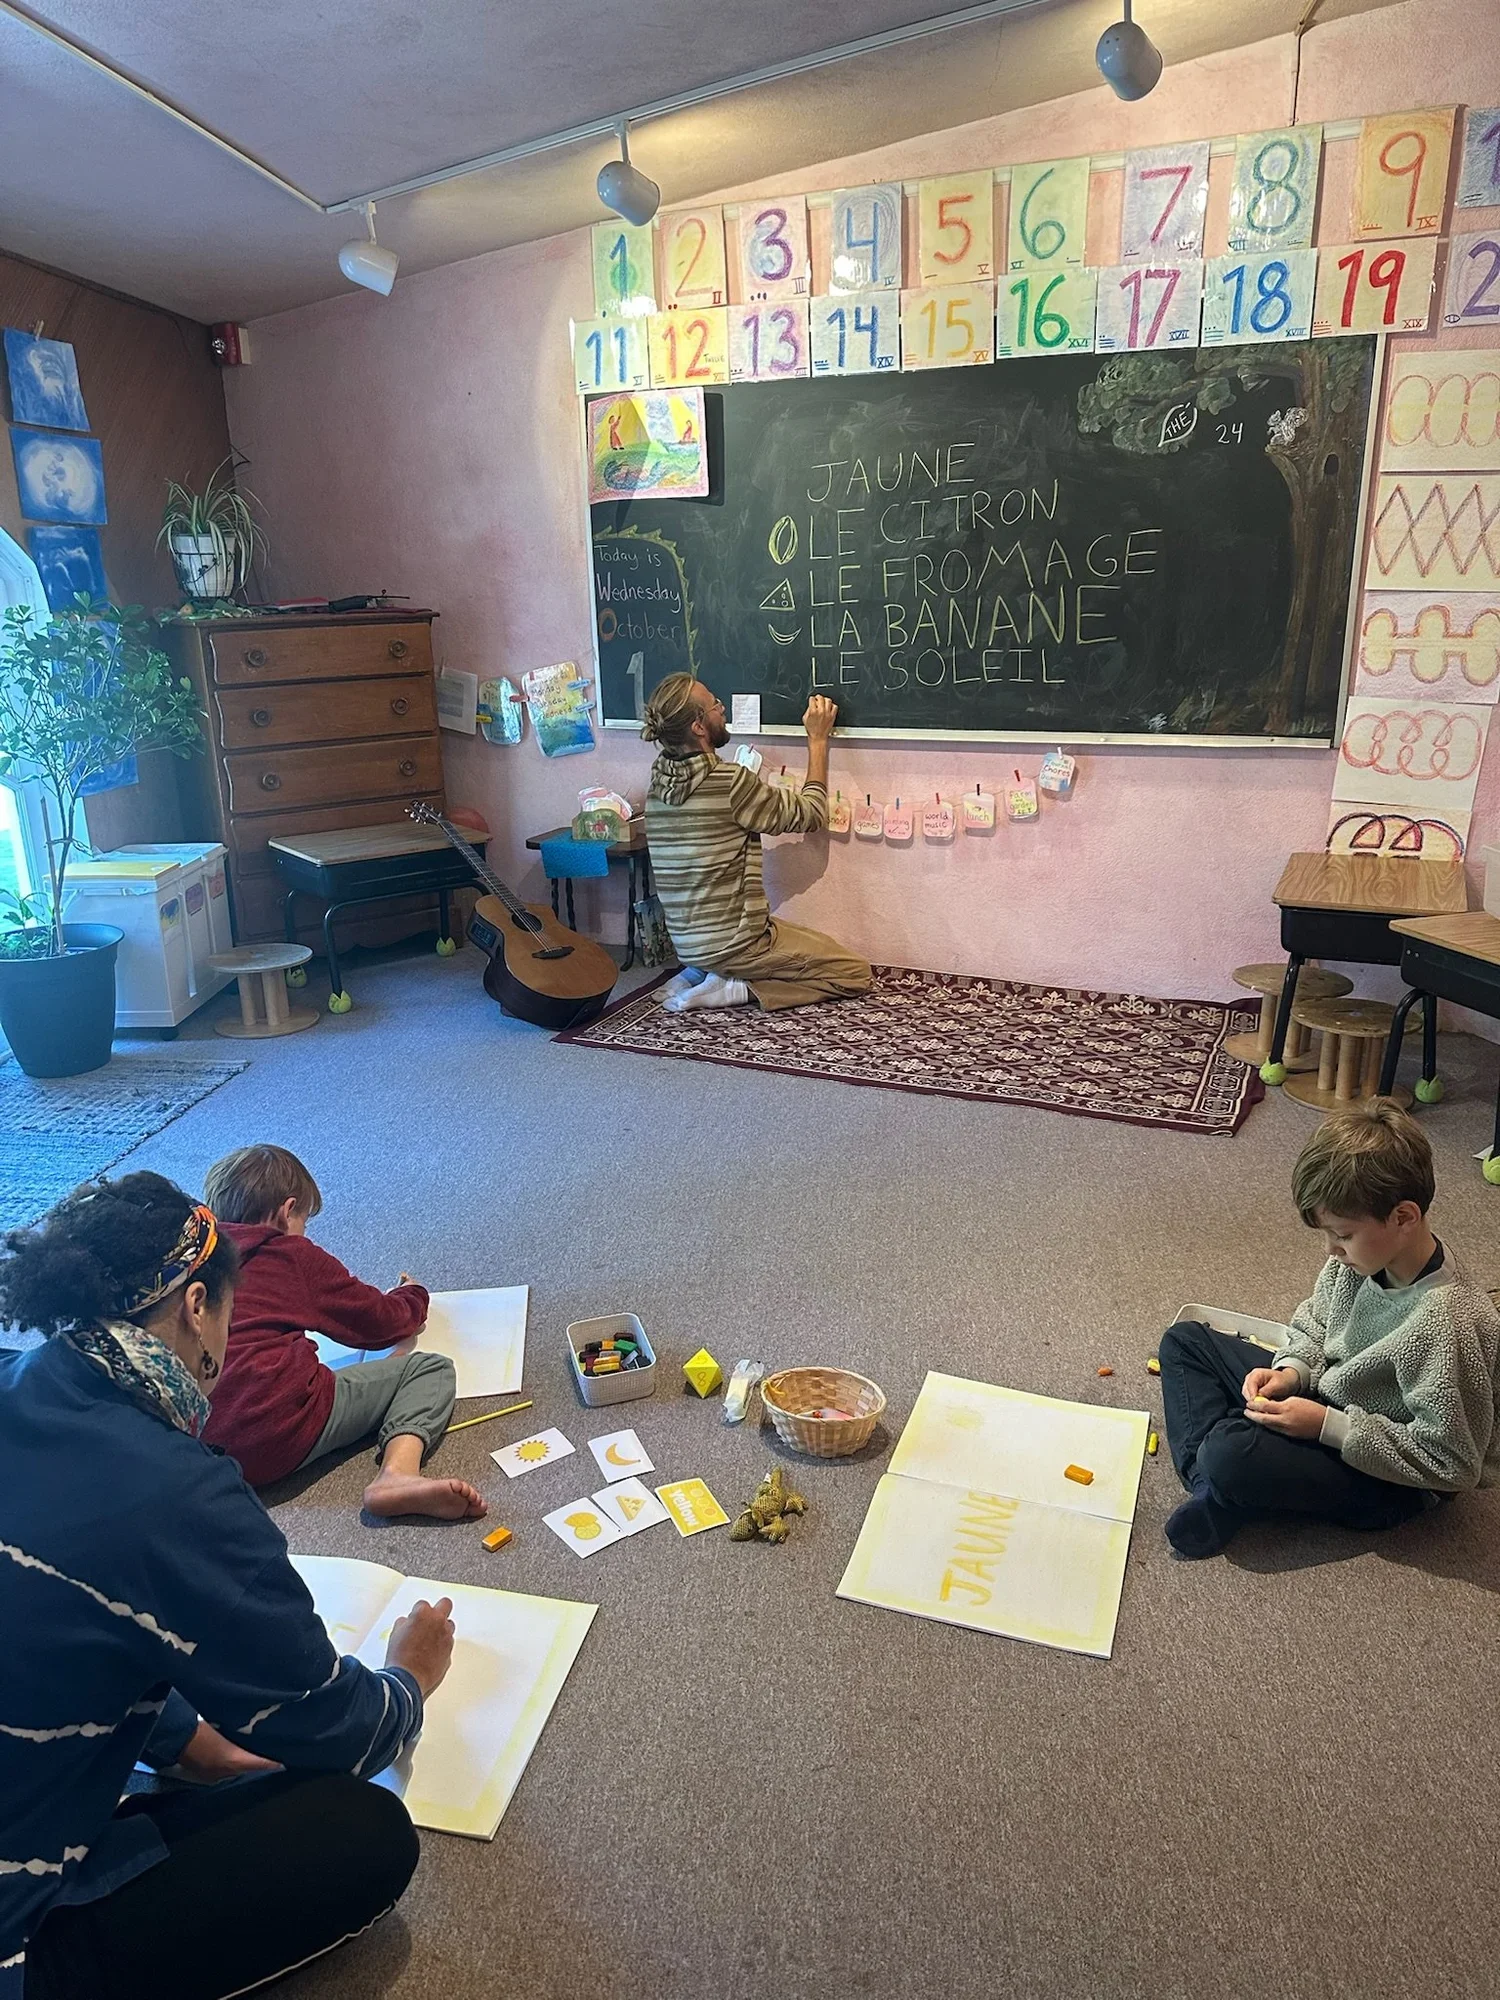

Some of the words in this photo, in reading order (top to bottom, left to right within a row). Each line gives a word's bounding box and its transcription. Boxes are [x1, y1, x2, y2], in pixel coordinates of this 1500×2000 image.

[1139, 164, 1193, 243] 7
[1246, 138, 1302, 236] 8
[1379, 130, 1427, 227] 9
[846, 201, 878, 283] 4
[933, 194, 974, 265] 5
[1020, 167, 1065, 260] 6
[1415, 215, 1438, 231] IX
[609, 233, 627, 301] 1
[676, 218, 713, 297] 2
[755, 208, 793, 281] 3
[977, 263, 990, 275] V
[1010, 260, 1025, 270] VI
[1010, 274, 1070, 348] 16
[1119, 269, 1182, 348] 17
[1222, 260, 1293, 335] 18
[1338, 249, 1406, 328] 19
[662, 319, 711, 379] 12
[743, 308, 798, 376] 13
[826, 305, 877, 367] 14
[920, 299, 975, 359] 15
[1068, 337, 1091, 349] XVI
[1168, 329, 1190, 342] XVII
[1401, 319, 1423, 329] XIX
[586, 326, 627, 386] 11
[876, 355, 894, 369] XIV
[973, 350, 989, 363] XV
[1215, 422, 1243, 444] 24
[807, 442, 975, 503] JAUNE
[809, 508, 865, 560] LE
[879, 479, 1059, 545] CITRON
[594, 544, 639, 571] Today
[646, 548, 662, 568] is
[808, 565, 861, 607] LE
[883, 528, 1163, 598] FROMAGE
[596, 571, 682, 614] Wednesday
[811, 609, 863, 648] LA
[883, 584, 1121, 649] BANANE
[599, 607, 680, 641] October
[627, 650, 647, 720] 1
[812, 650, 865, 688] LE
[884, 646, 1066, 691] SOLEIL
[857, 821, 880, 832] games
[925, 812, 949, 820] world
[925, 821, 948, 829] music
[967, 810, 990, 821] lunch
[697, 1371, 707, 1387] 8
[940, 1491, 1020, 1606] JAUNE
